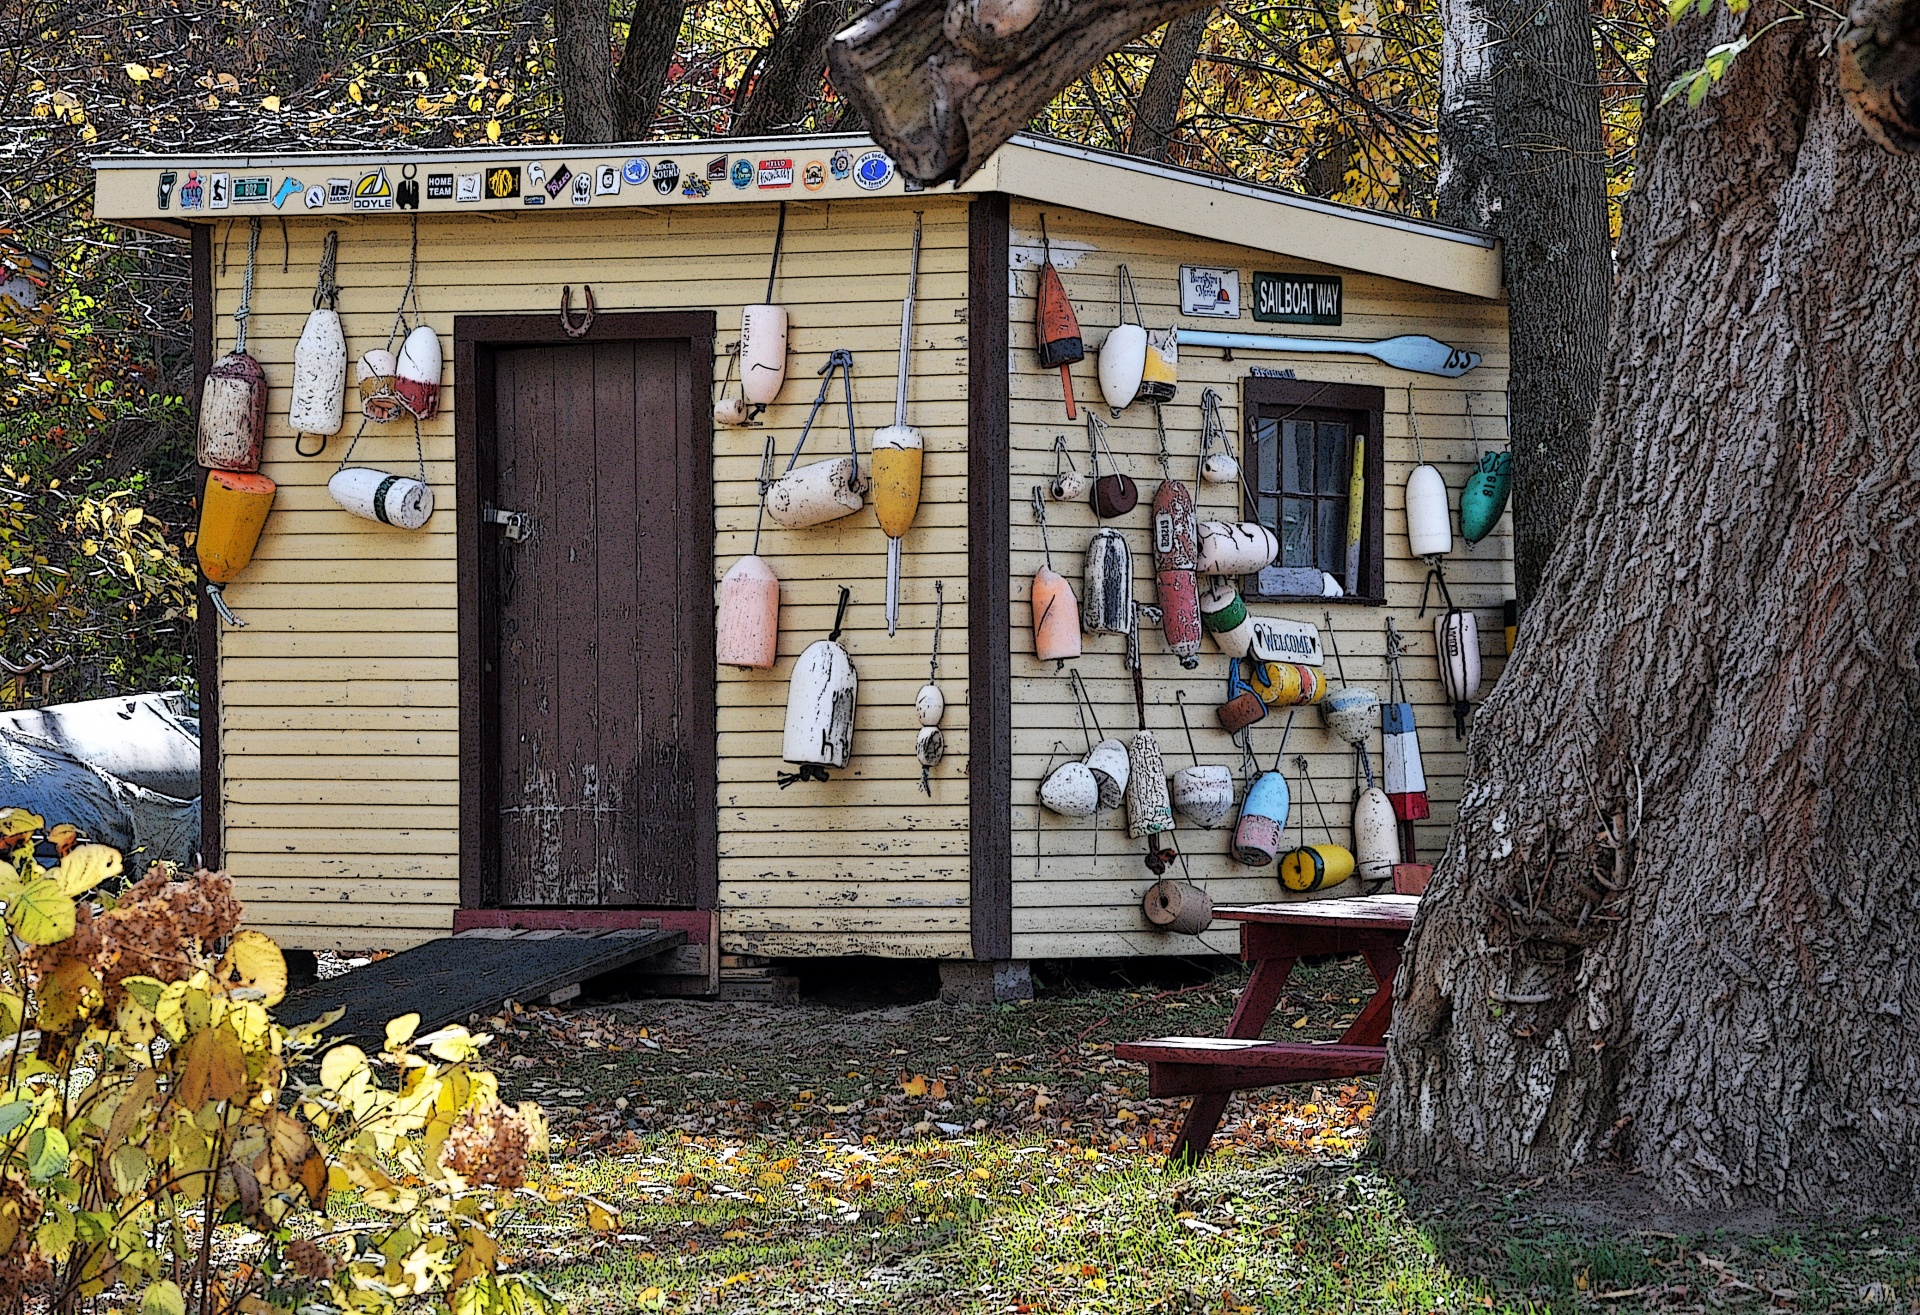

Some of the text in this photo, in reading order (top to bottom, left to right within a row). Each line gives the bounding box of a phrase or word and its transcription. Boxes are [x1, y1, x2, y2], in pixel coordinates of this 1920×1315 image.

[652, 168, 680, 180] SOUND
[428, 177, 452, 186] HOME
[244, 183, 258, 196] 802
[331, 185, 349, 196] US
[429, 187, 452, 196] TEAM
[354, 199, 392, 208] DOYLE
[1259, 280, 1339, 315] SAILBOAT WAY
[1254, 623, 1312, 655] WELCOME
